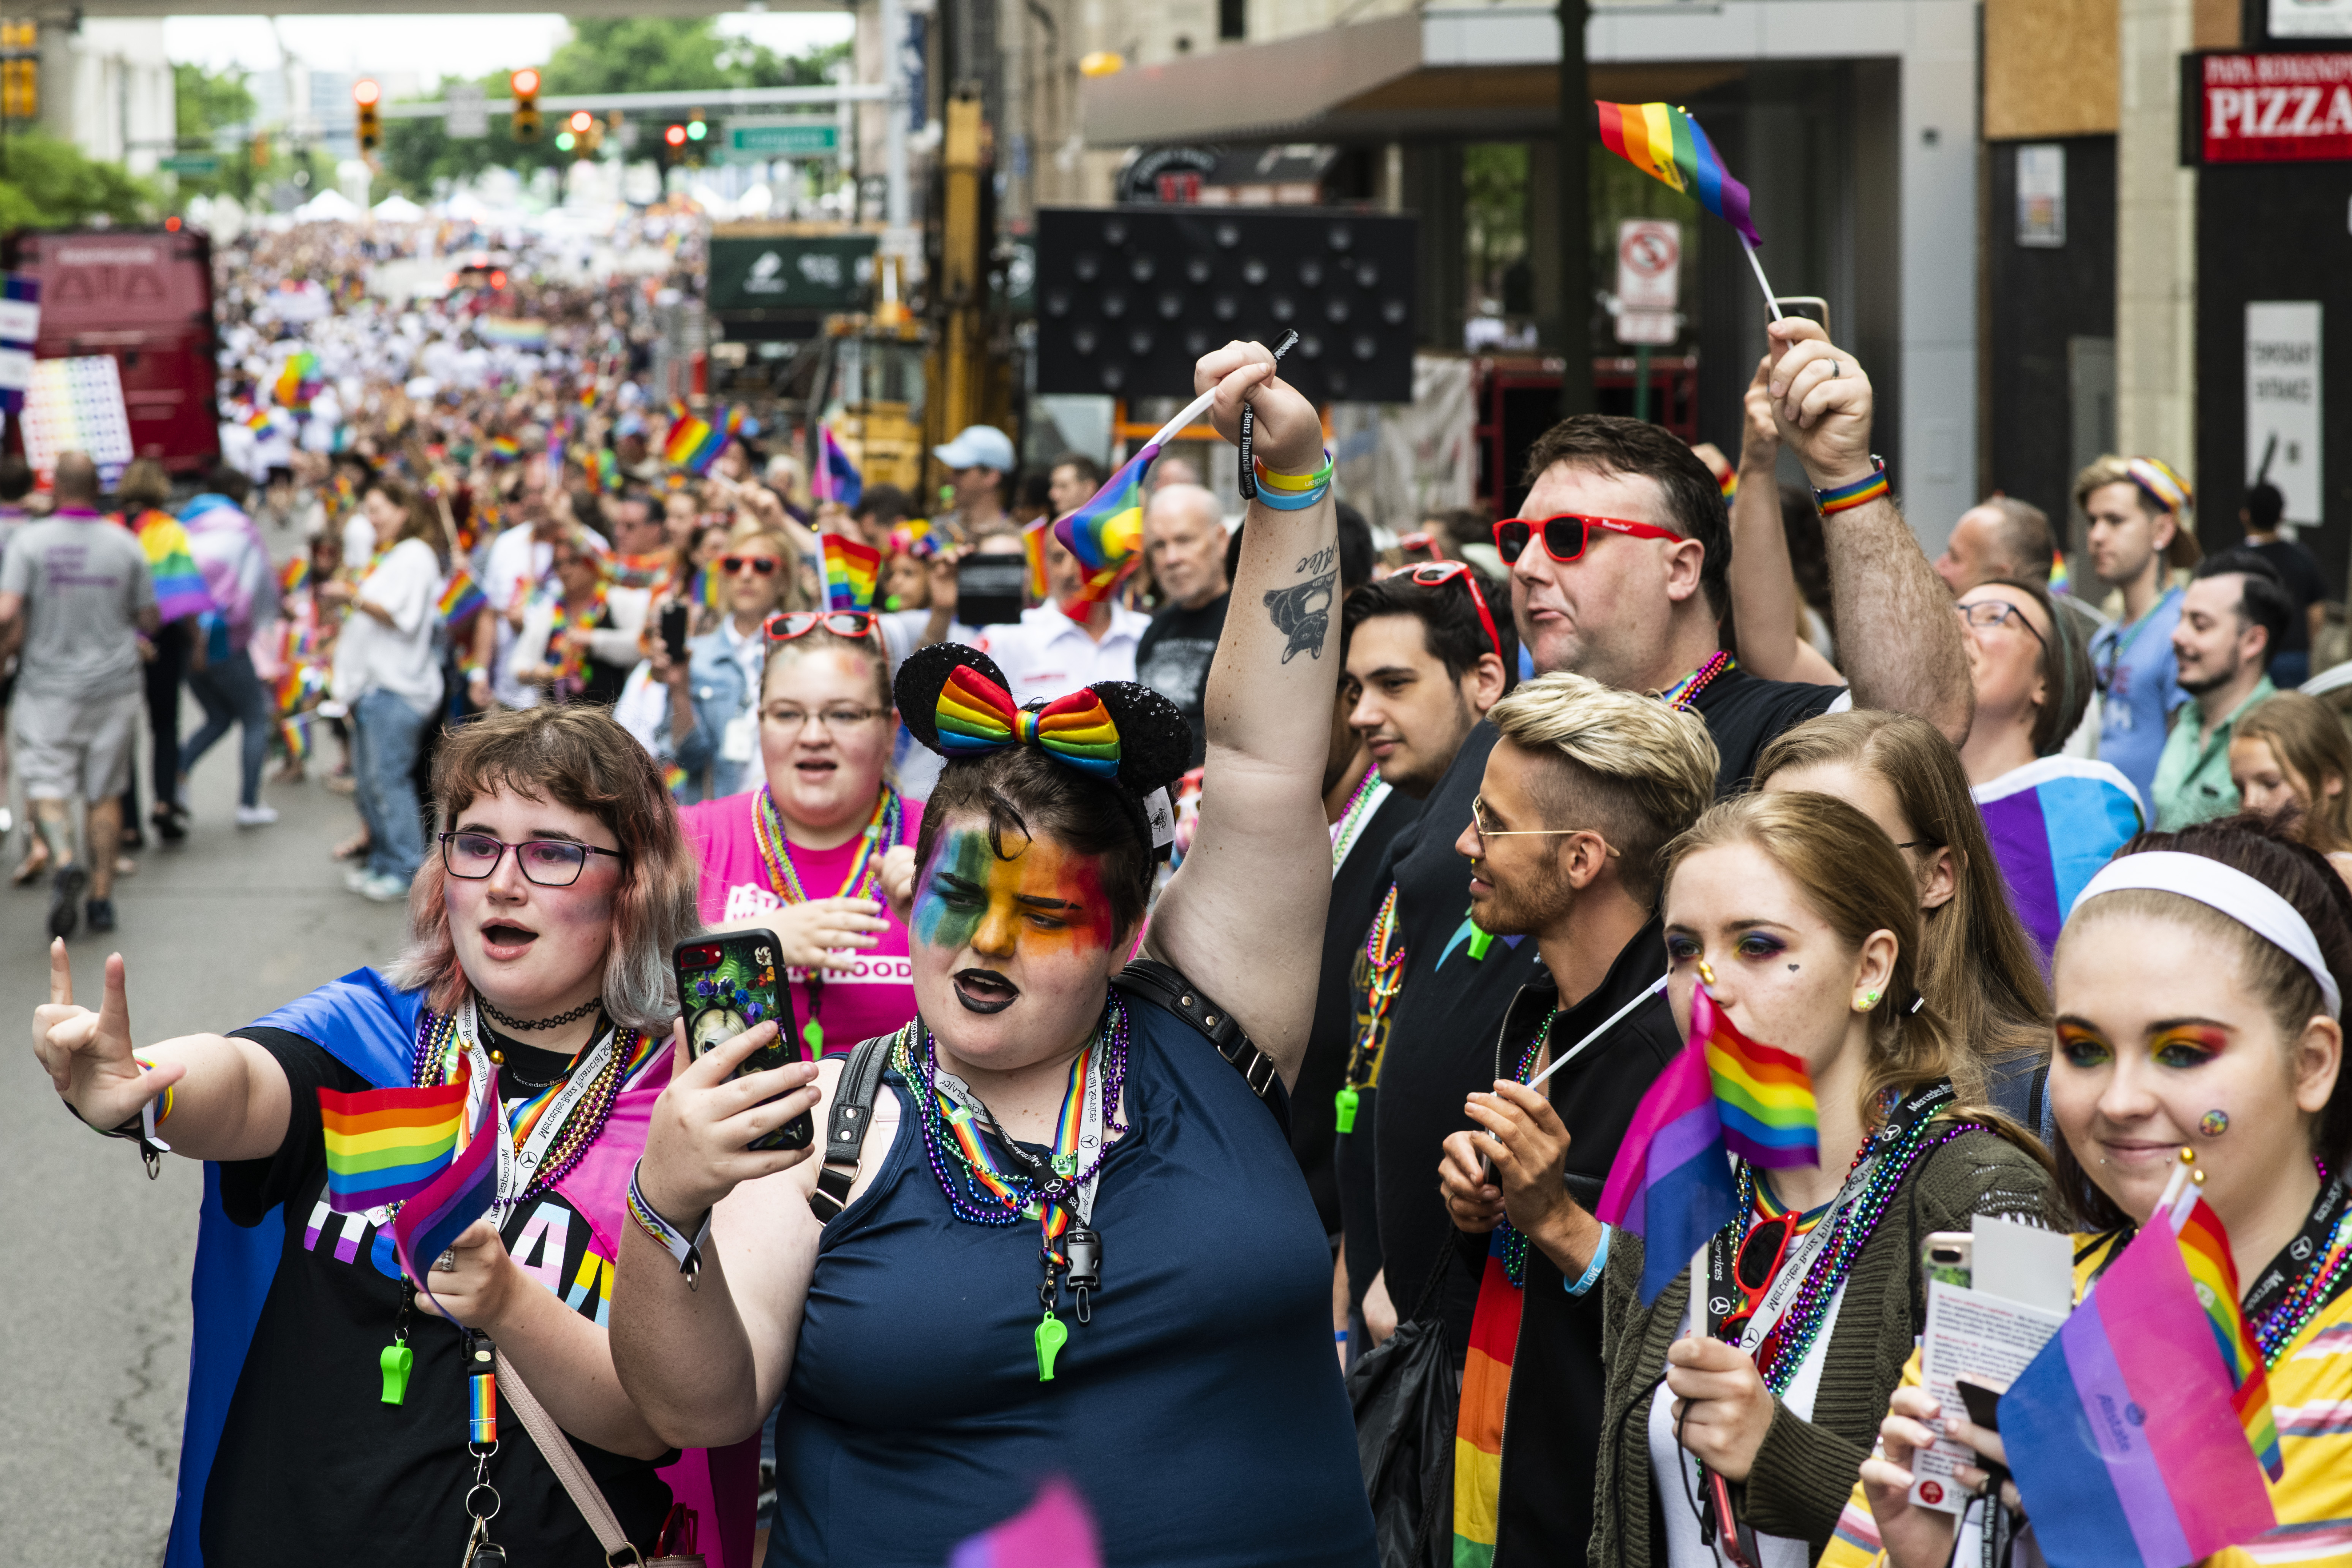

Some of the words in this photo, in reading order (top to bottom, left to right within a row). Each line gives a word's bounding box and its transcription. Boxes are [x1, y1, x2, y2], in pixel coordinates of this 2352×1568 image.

[2206, 87, 2352, 139] PIZZA
[1242, 437, 1251, 472] Financial
[480, 1016, 495, 1044] Services
[513, 1072, 568, 1088] Mercedes-Benz
[1582, 1264, 1602, 1286] LOVE
[1714, 1239, 1723, 1281] Services
